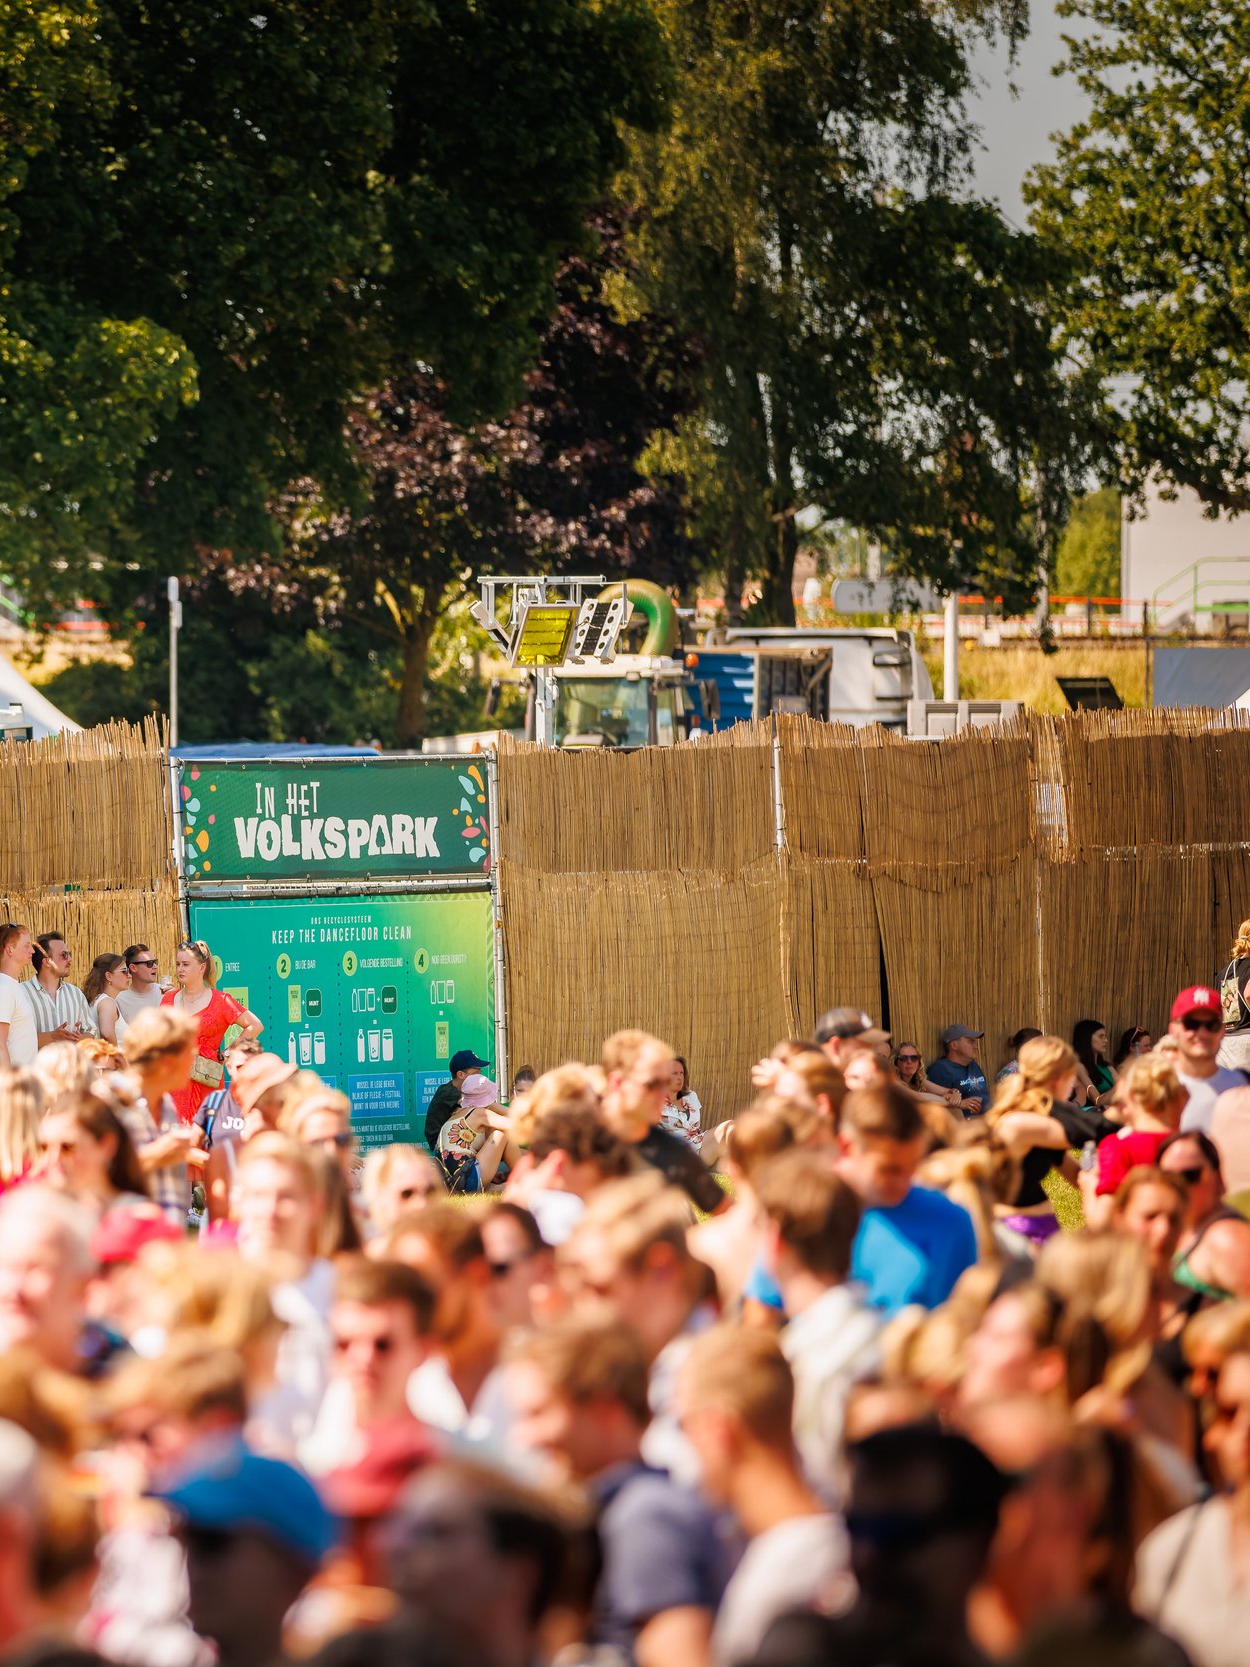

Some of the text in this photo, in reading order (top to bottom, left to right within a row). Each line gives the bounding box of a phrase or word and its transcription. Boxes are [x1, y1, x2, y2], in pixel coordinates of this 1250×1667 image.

[255, 782, 320, 818] IN HET
[234, 814, 440, 861] VOLKSPARK
[272, 926, 412, 944] KEEP THE DANCEFLOOR CLEAN
[280, 959, 287, 973] 2
[347, 957, 353, 970] 3
[418, 954, 425, 967] 4
